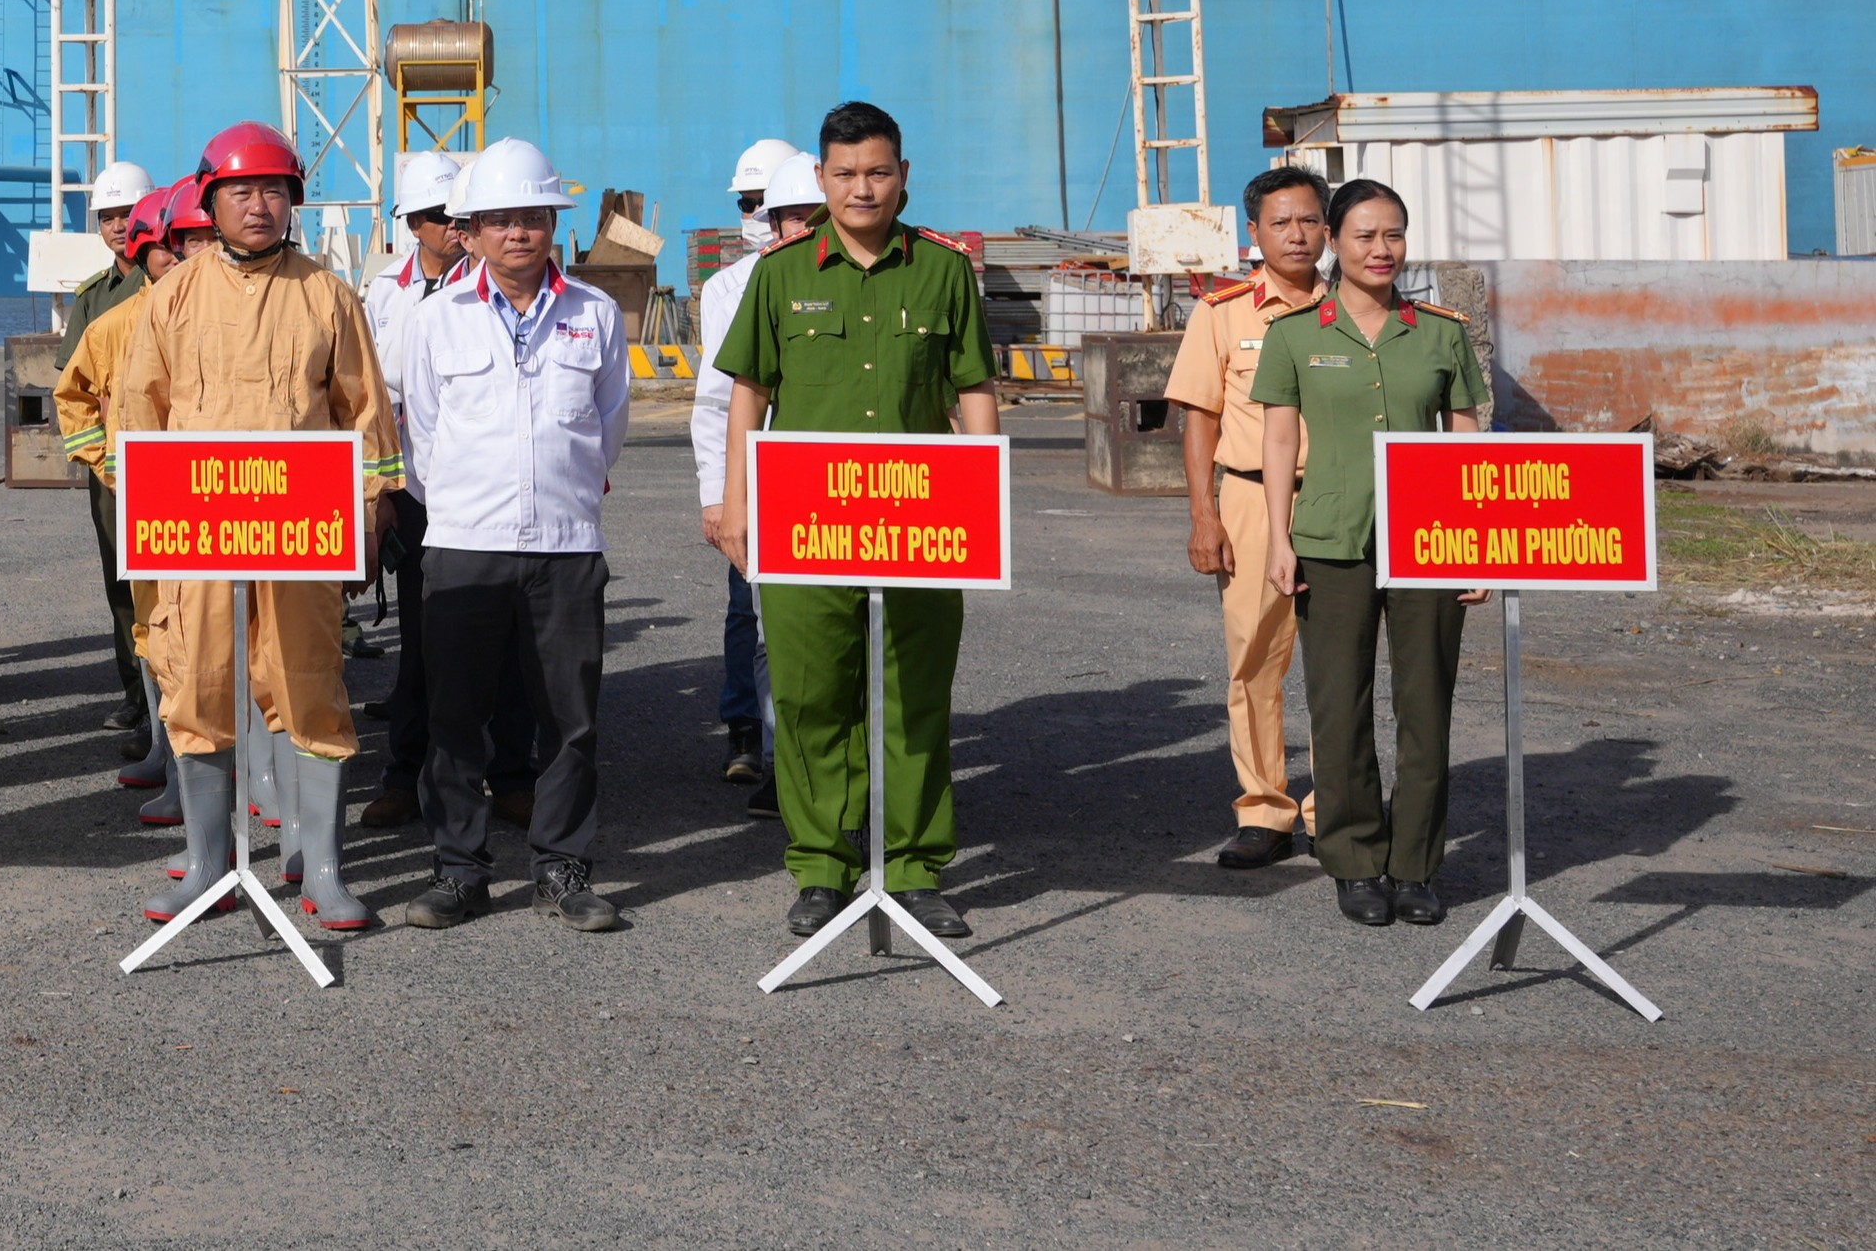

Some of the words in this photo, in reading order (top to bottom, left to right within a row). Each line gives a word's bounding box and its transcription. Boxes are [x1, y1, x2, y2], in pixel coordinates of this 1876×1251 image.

[190, 456, 224, 502] LỰC
[229, 456, 287, 502] LƯỢNG
[827, 458, 862, 506] LỰC
[868, 459, 930, 507] LƯỢNG
[1461, 460, 1499, 508] LỰC
[1505, 460, 1570, 508] LƯỢNG
[136, 519, 190, 555] PCCC
[197, 520, 213, 555] &
[219, 520, 275, 556] CNCH
[282, 517, 310, 556] CƠ
[315, 509, 344, 557] SỞ
[791, 512, 853, 560] CẢNH
[859, 518, 901, 561] SÁT
[907, 526, 967, 563] PCCC
[1414, 520, 1479, 565] CÔNG
[1486, 527, 1518, 564] AN
[1526, 518, 1622, 565] PHƯỜNG
